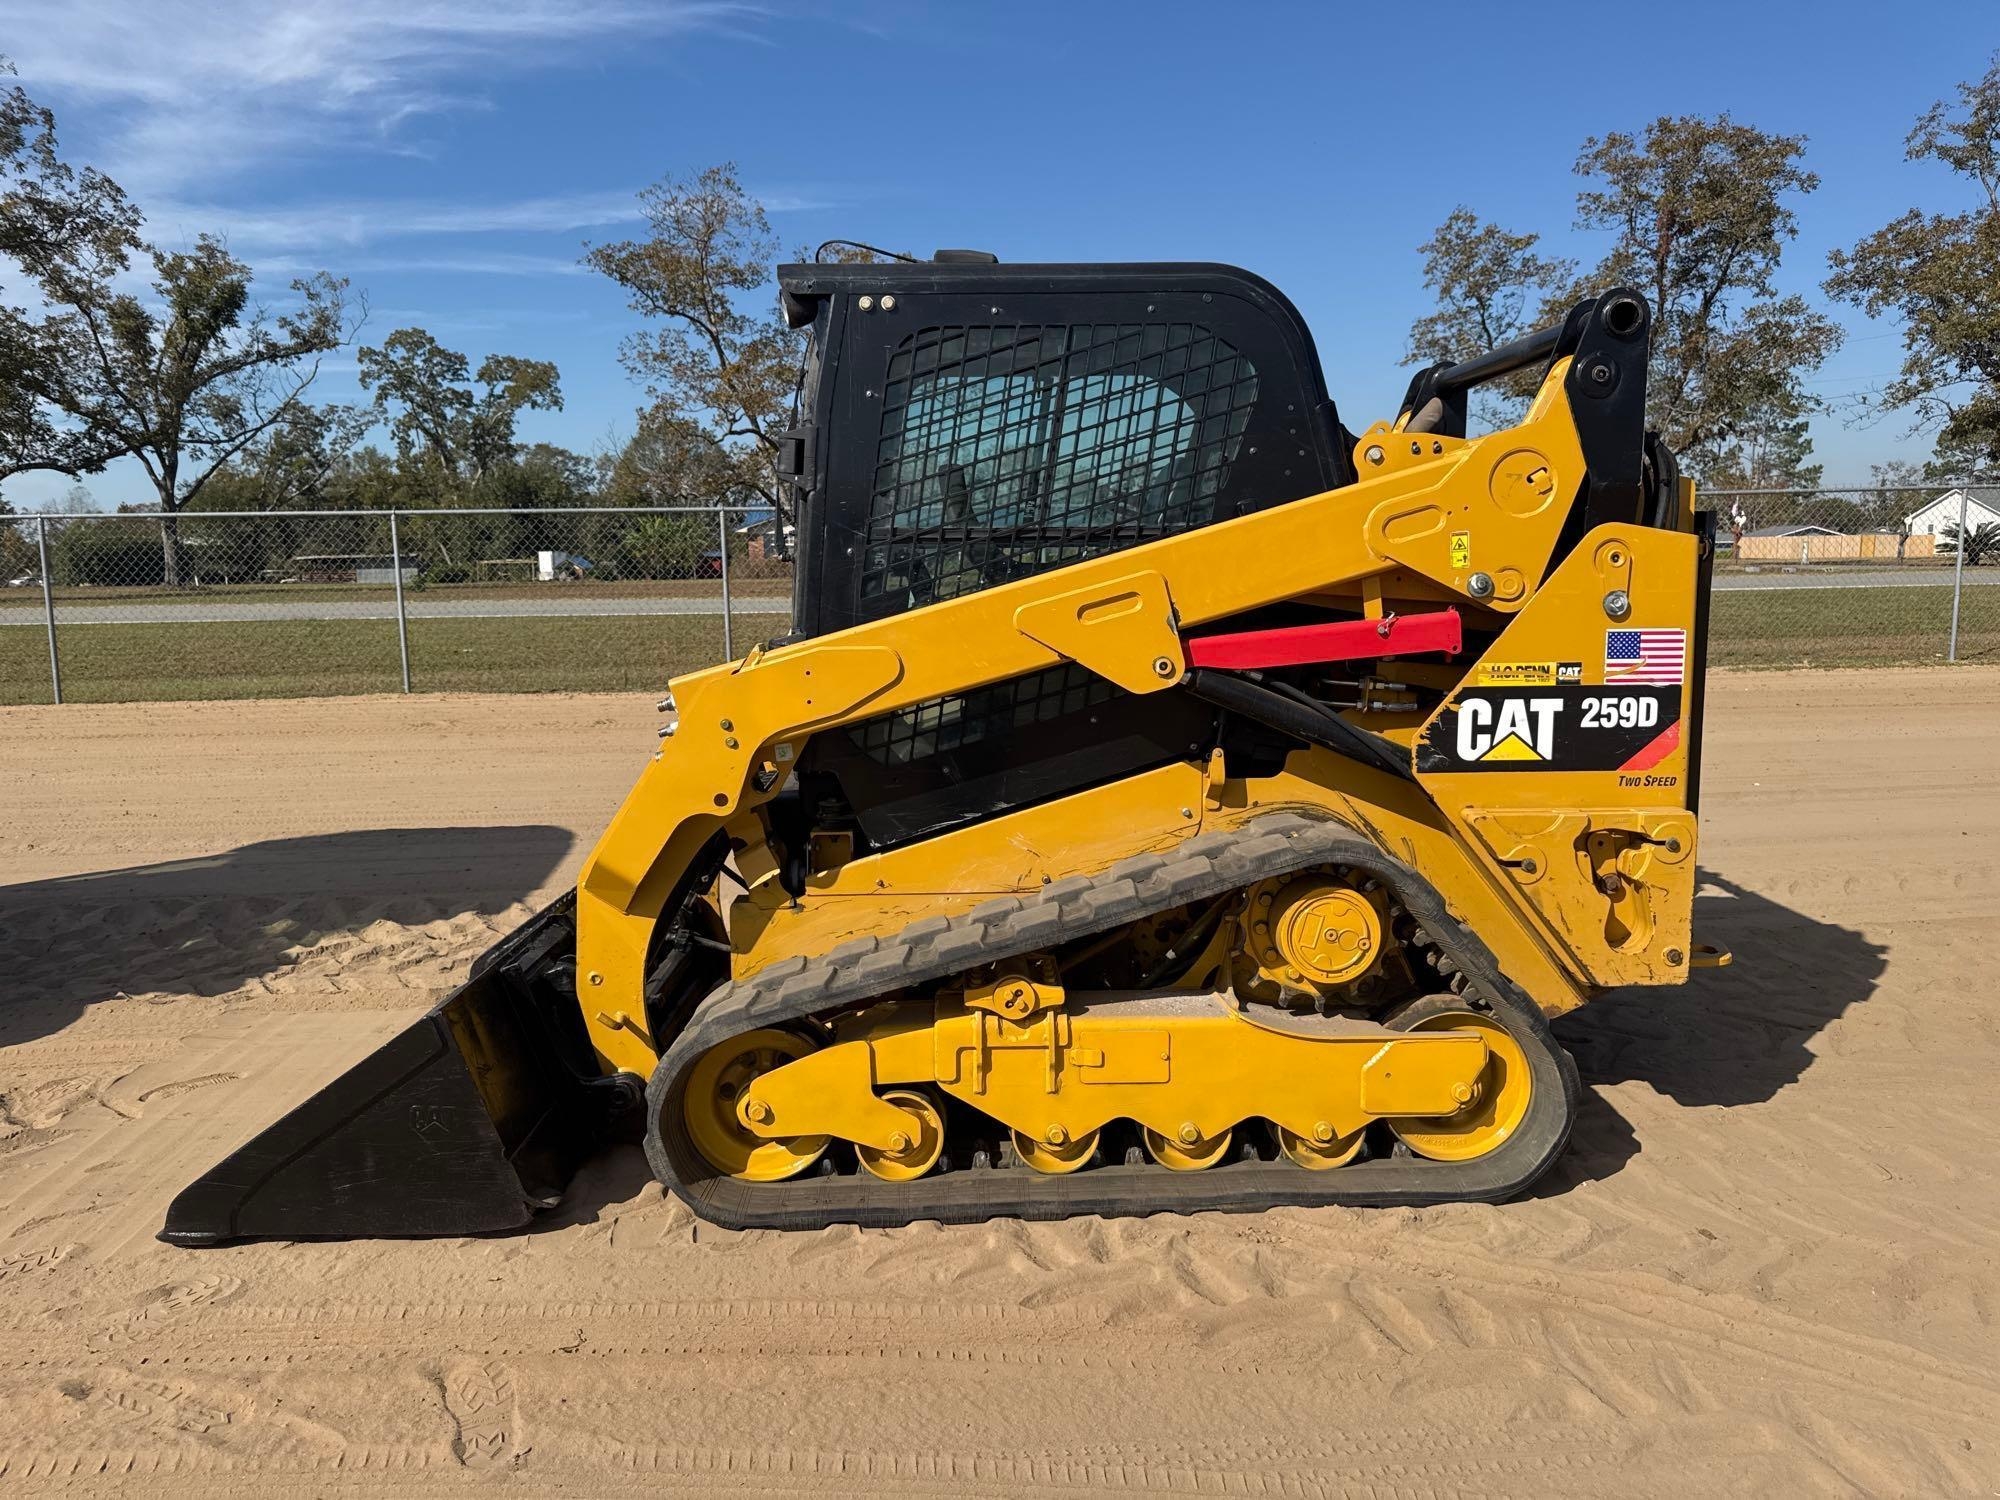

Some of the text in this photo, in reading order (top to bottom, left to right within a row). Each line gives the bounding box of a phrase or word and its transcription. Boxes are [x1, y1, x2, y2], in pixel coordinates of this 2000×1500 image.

[1558, 666, 1581, 681] CAT
[1457, 697, 1659, 762] CAT 259D
